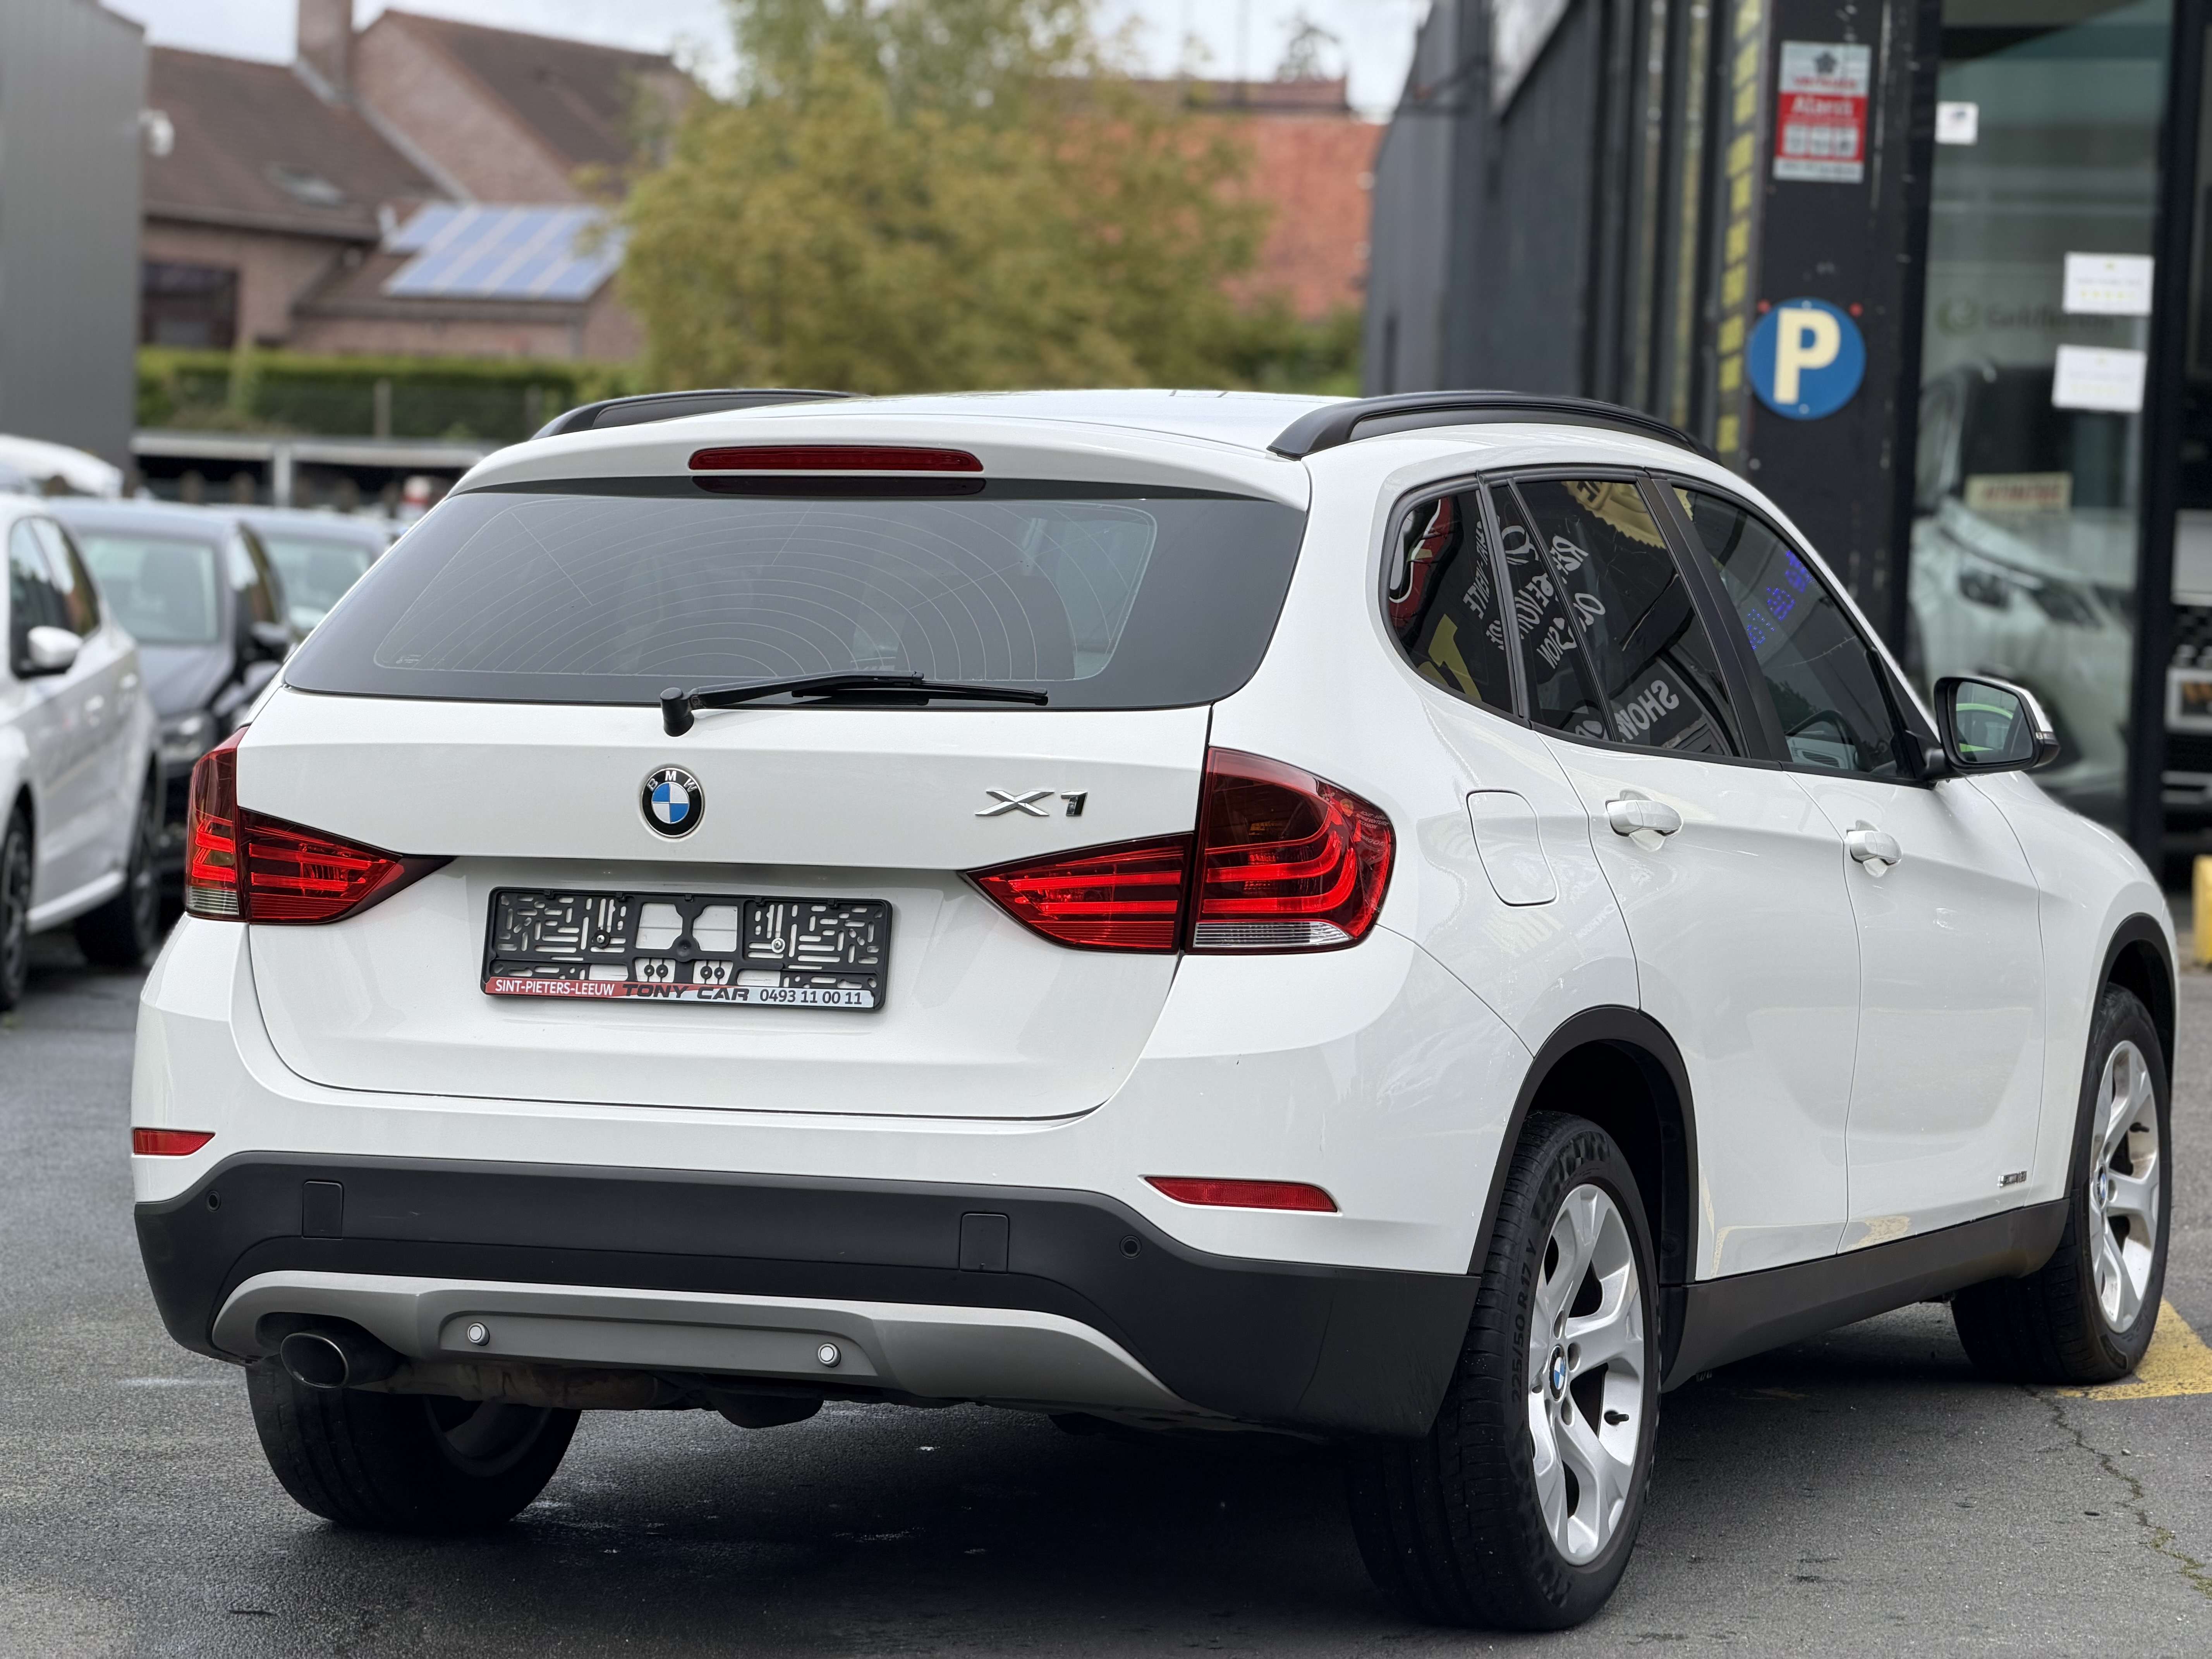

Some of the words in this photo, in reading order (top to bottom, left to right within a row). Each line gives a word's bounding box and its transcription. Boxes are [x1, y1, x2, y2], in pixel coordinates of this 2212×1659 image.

[1773, 307, 1841, 404] P
[647, 770, 697, 793] BMW
[974, 790, 1088, 816] X1
[495, 979, 615, 996] SINT-PIETERS-LEEUW
[622, 984, 689, 998] TONY
[697, 986, 750, 1001] CAR
[759, 989, 796, 1003] 0493
[800, 990, 818, 1003] 11
[822, 991, 841, 1004] 00
[844, 991, 862, 1005] 11
[1512, 1314, 1526, 1403] 225/50
[1520, 1262, 1532, 1287] 17
